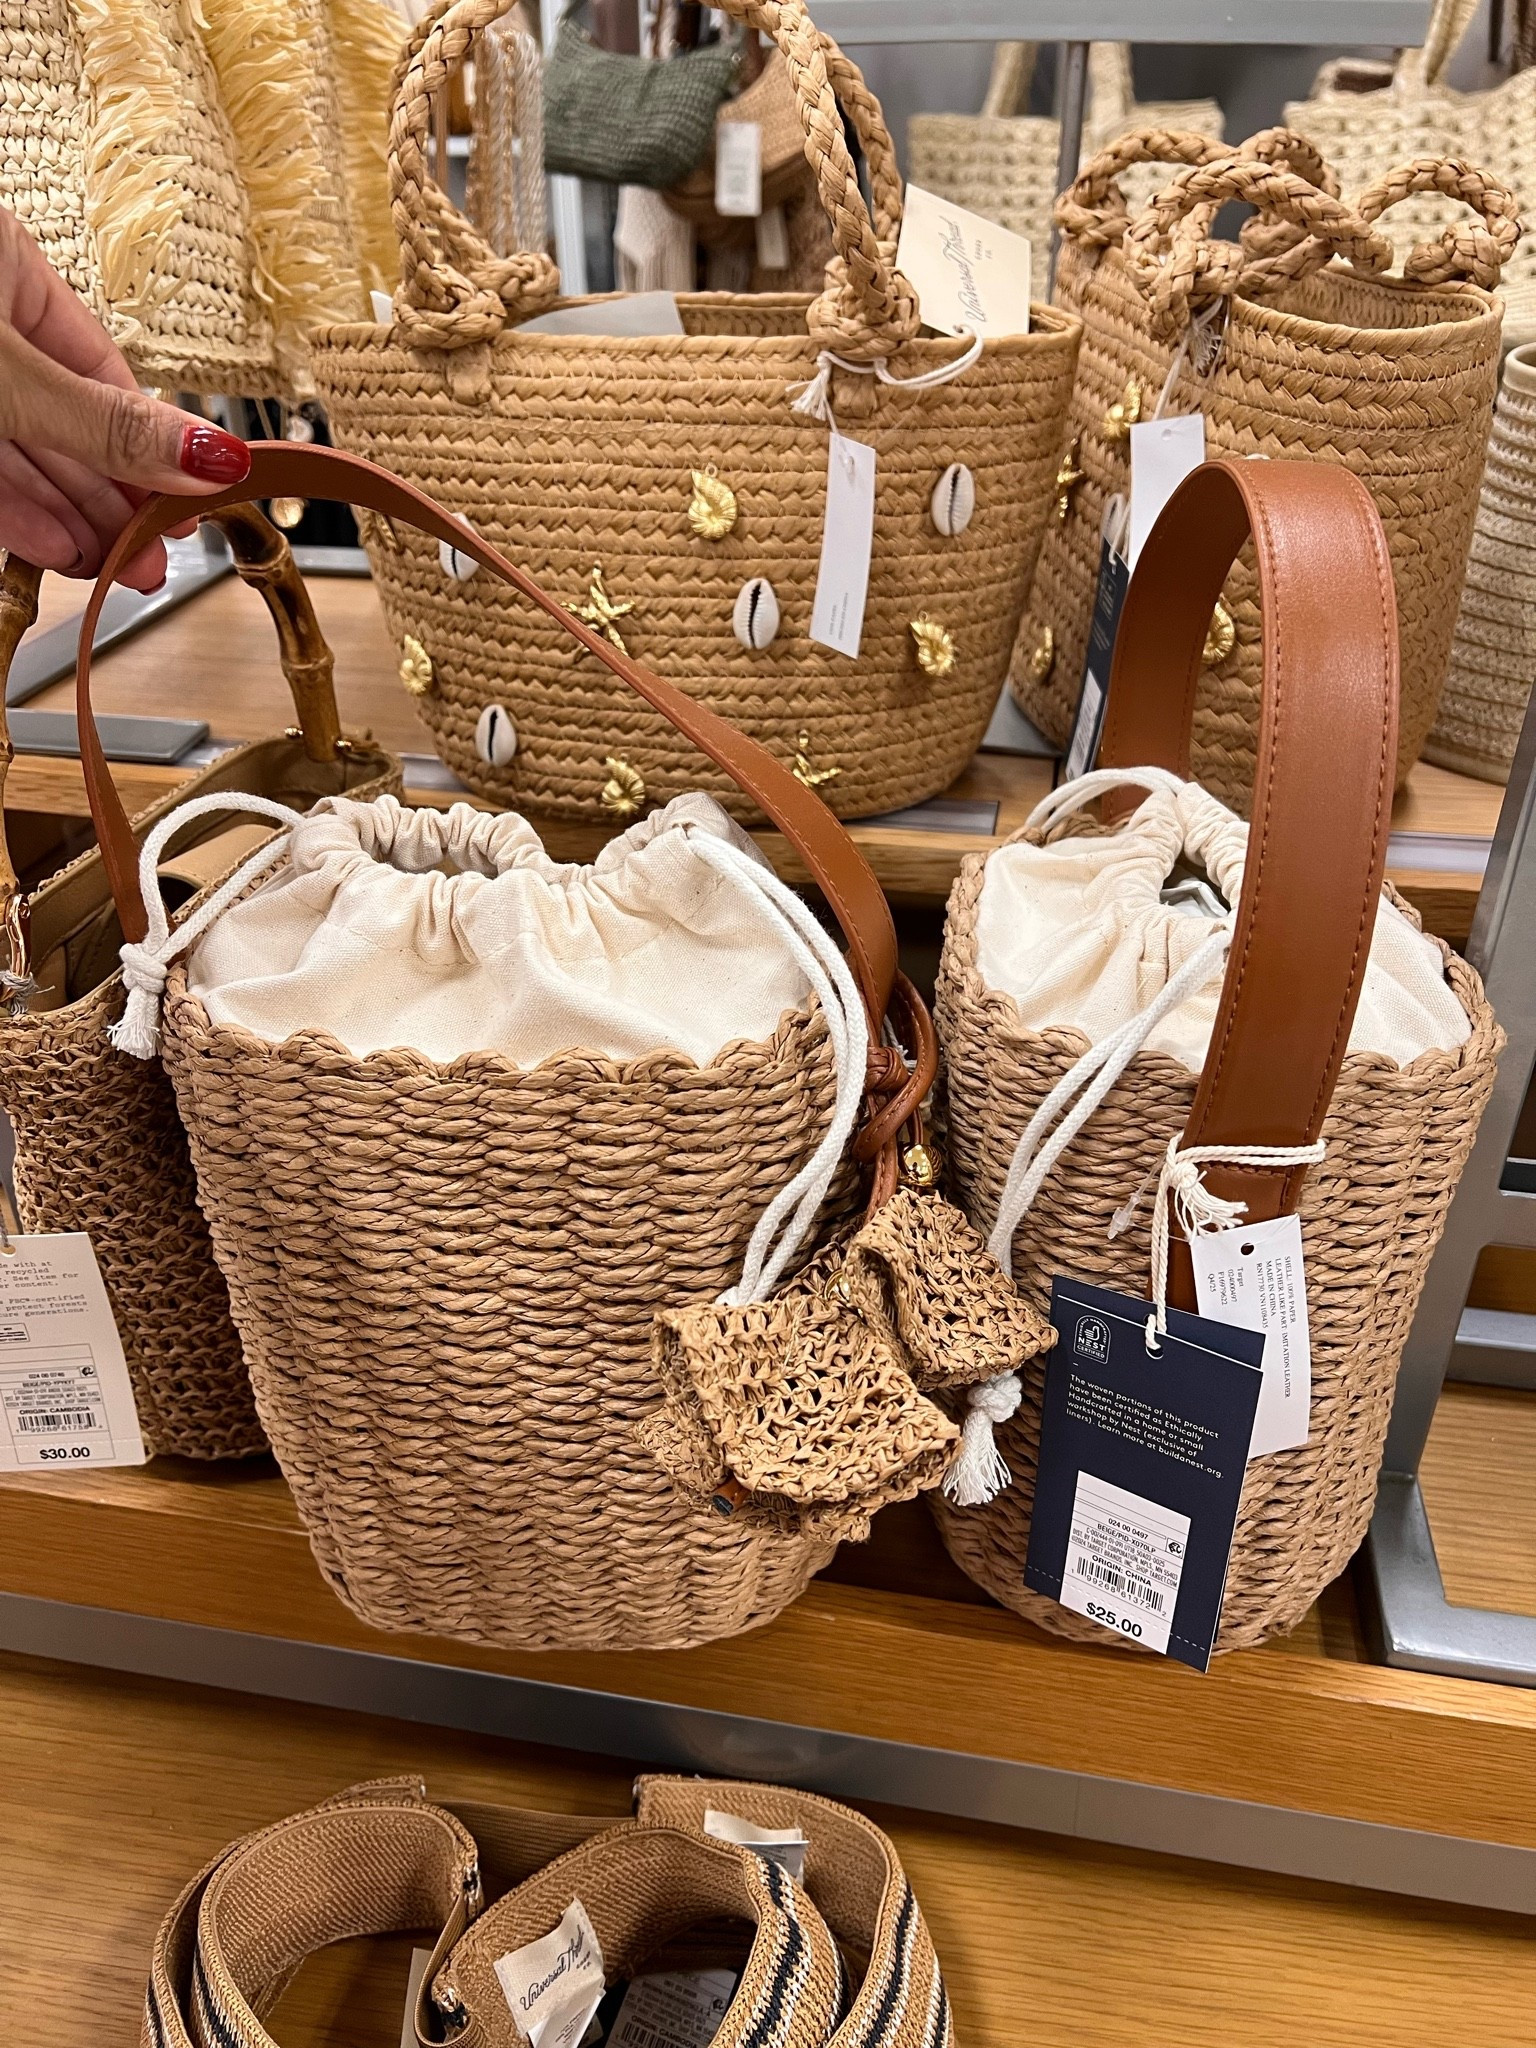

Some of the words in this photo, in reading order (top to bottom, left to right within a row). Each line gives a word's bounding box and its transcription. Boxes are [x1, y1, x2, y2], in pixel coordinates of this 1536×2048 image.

[1266, 1261, 1274, 1283] MADE
[1268, 1284, 1274, 1292] IN
[1275, 1258, 1284, 1292] LEATHER
[1282, 1333, 1290, 1368] IMITATION
[1077, 1345, 1105, 1358] CERTIFIED
[1078, 1337, 1105, 1351] NEST
[1068, 1391, 1122, 1417] Handcrafted
[1124, 1413, 1132, 1421] in
[1142, 1421, 1166, 1435] home
[1180, 1438, 1204, 1451] small
[1069, 1383, 1089, 1396] have
[1092, 1392, 1111, 1404] been
[1114, 1402, 1151, 1420] certified
[1153, 1417, 1162, 1425] as
[1165, 1421, 1202, 1442] Ethically
[1071, 1374, 1085, 1385] The
[1087, 1382, 1114, 1396] woven
[1116, 1393, 1152, 1411] portions
[1165, 1412, 1181, 1423] this
[1184, 1421, 1219, 1438] product
[1066, 1408, 1095, 1425] liners).
[1097, 1420, 1121, 1435] Learn
[1123, 1432, 1145, 1445] more
[1147, 1442, 1156, 1450] at
[1158, 1445, 1224, 1478] buildanest.org.
[1067, 1401, 1107, 1420] workshop
[1109, 1416, 1119, 1426] by
[1121, 1421, 1141, 1435] Nest
[1144, 1430, 1185, 1452] (exclusive
[40, 1447, 90, 1459] $30.00
[1108, 1518, 1121, 1528] 024
[1122, 1524, 1131, 1532] 00
[1132, 1529, 1148, 1540] 0497
[1087, 1541, 1103, 1554] TARGET
[1136, 1564, 1148, 1574] SHOP
[1149, 1570, 1178, 1587] TARGET.COM
[1090, 1536, 1107, 1548] TARGET
[1155, 1565, 1162, 1573] MN
[1092, 1555, 1123, 1573] ORIGIN:
[1125, 1570, 1151, 1586] CHINA
[1086, 1575, 1116, 1593] 99268
[1121, 1591, 1151, 1610] 61372
[1086, 1602, 1142, 1637] $25.00
[520, 1957, 567, 2011] Universal
